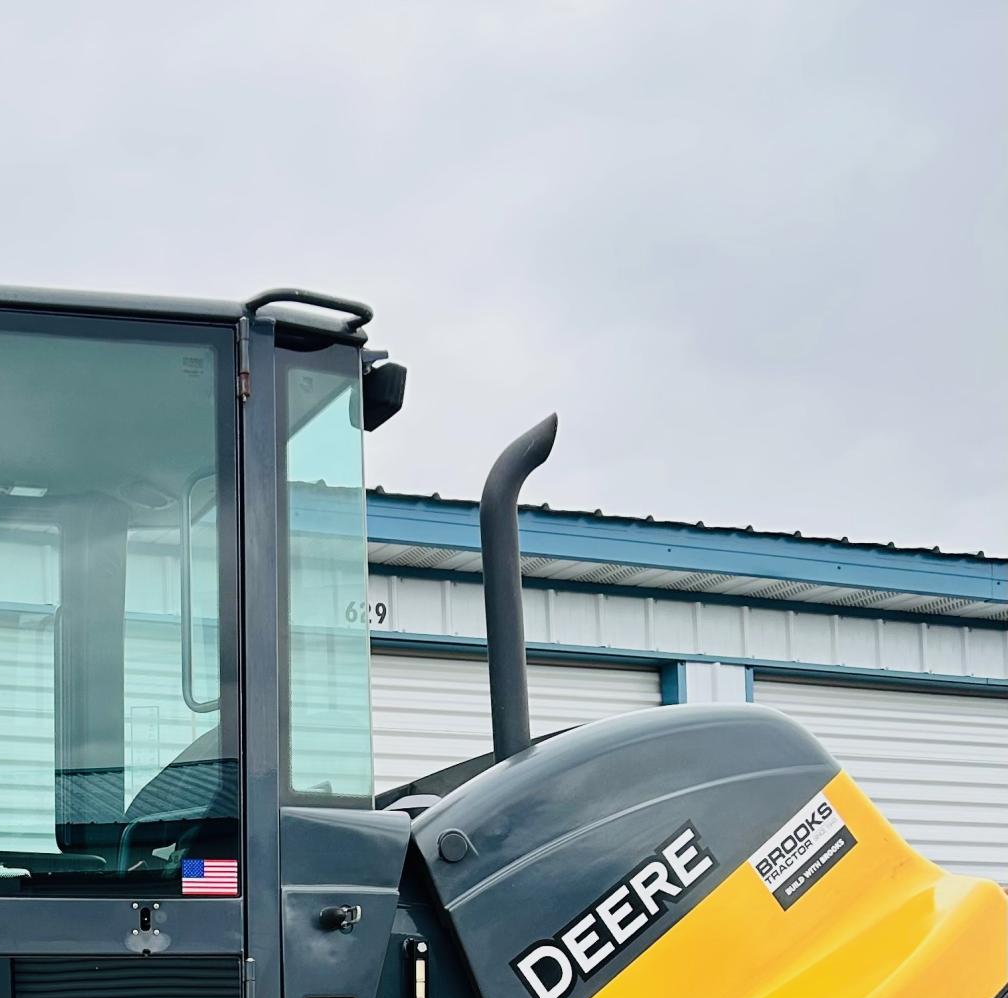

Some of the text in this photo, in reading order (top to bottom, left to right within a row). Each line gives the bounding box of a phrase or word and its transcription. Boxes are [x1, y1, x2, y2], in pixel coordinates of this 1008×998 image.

[346, 601, 387, 624] 629
[755, 801, 833, 878] BROOKS
[764, 839, 814, 885] TRACTOR
[784, 837, 845, 896] BUILD WITH BROOKS
